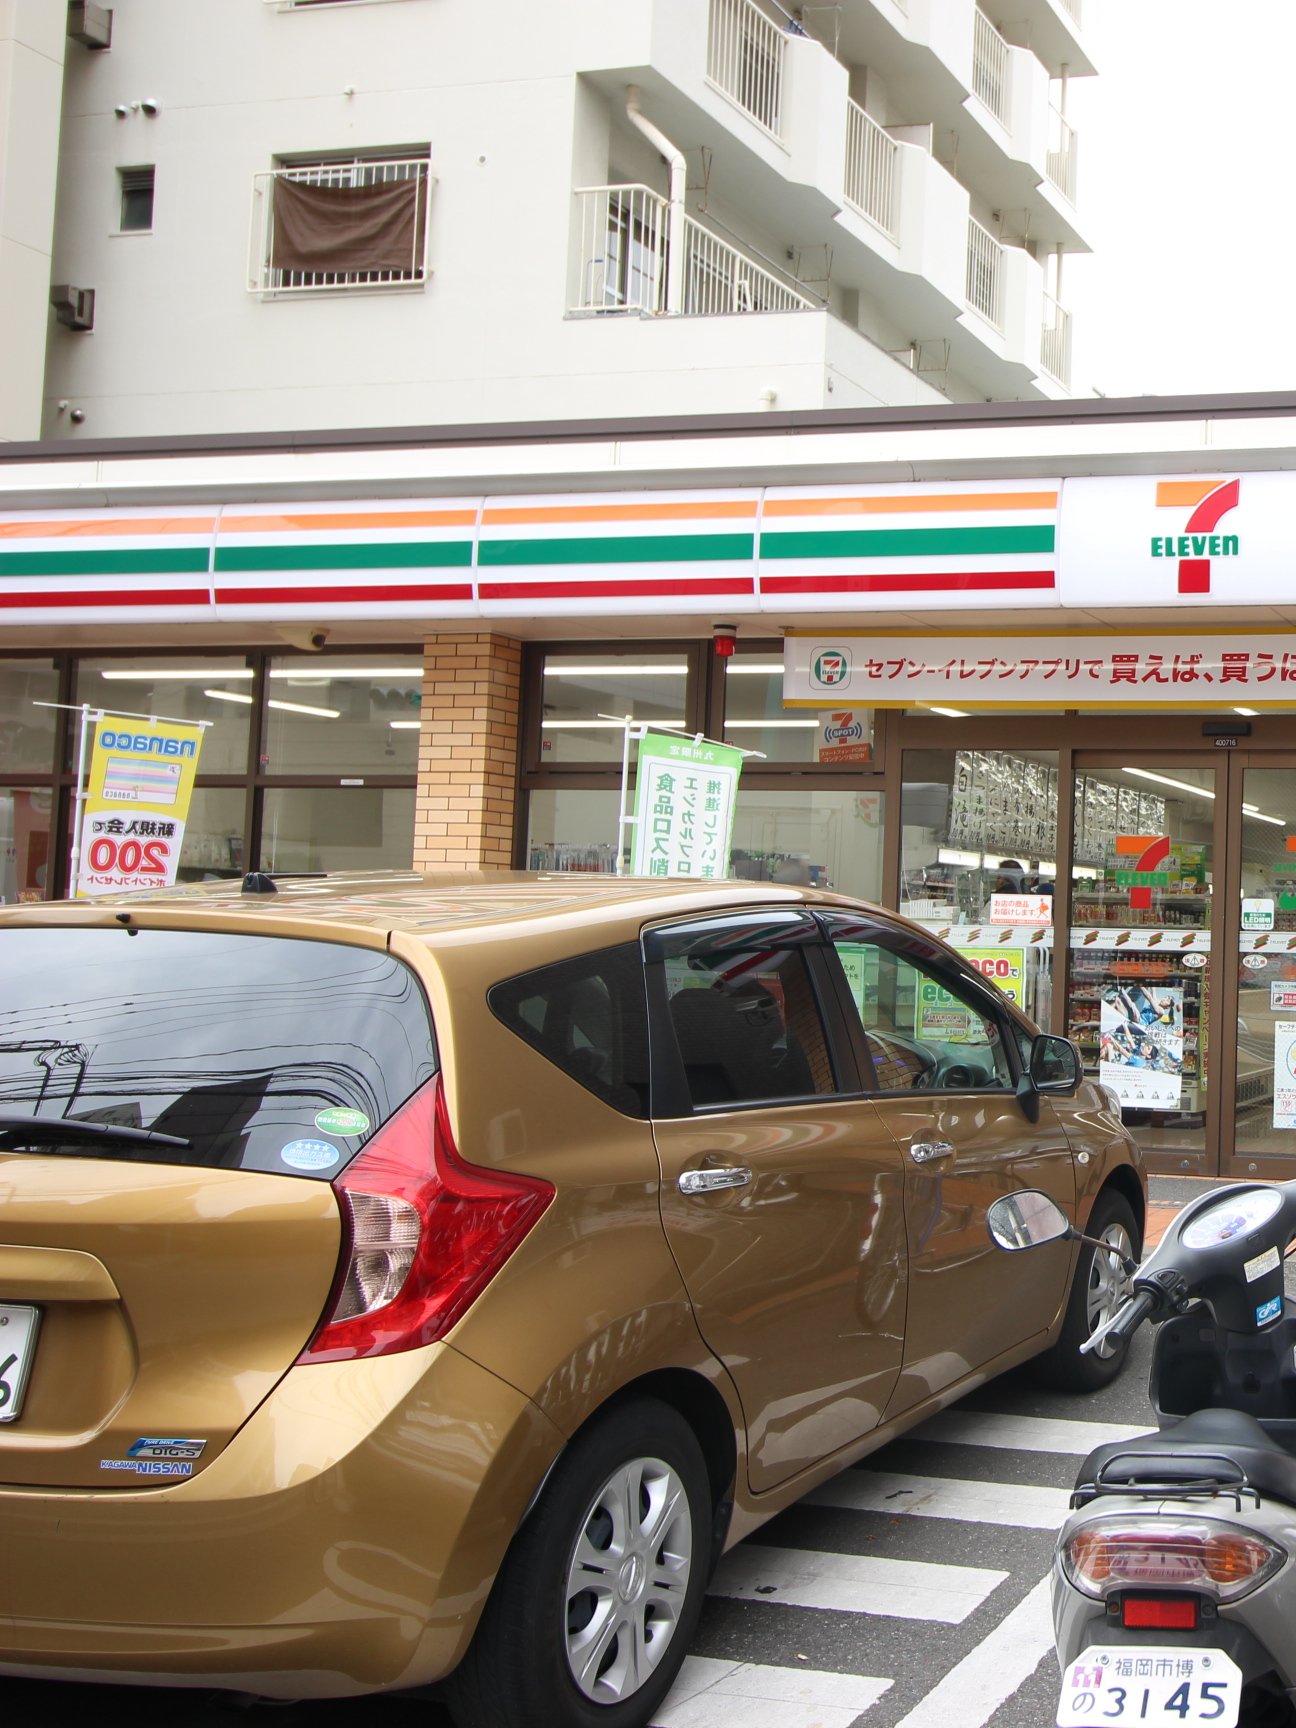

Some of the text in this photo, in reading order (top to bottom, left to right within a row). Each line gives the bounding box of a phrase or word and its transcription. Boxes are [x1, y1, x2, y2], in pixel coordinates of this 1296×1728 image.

[1155, 479, 1240, 593] 7
[151, 1447, 196, 1456] DIG-S
[101, 1460, 192, 1475] KAGAWA NISSAN
[1115, 1658, 1194, 1678] 福岡市博
[1072, 1682, 1228, 1719] の 3145
